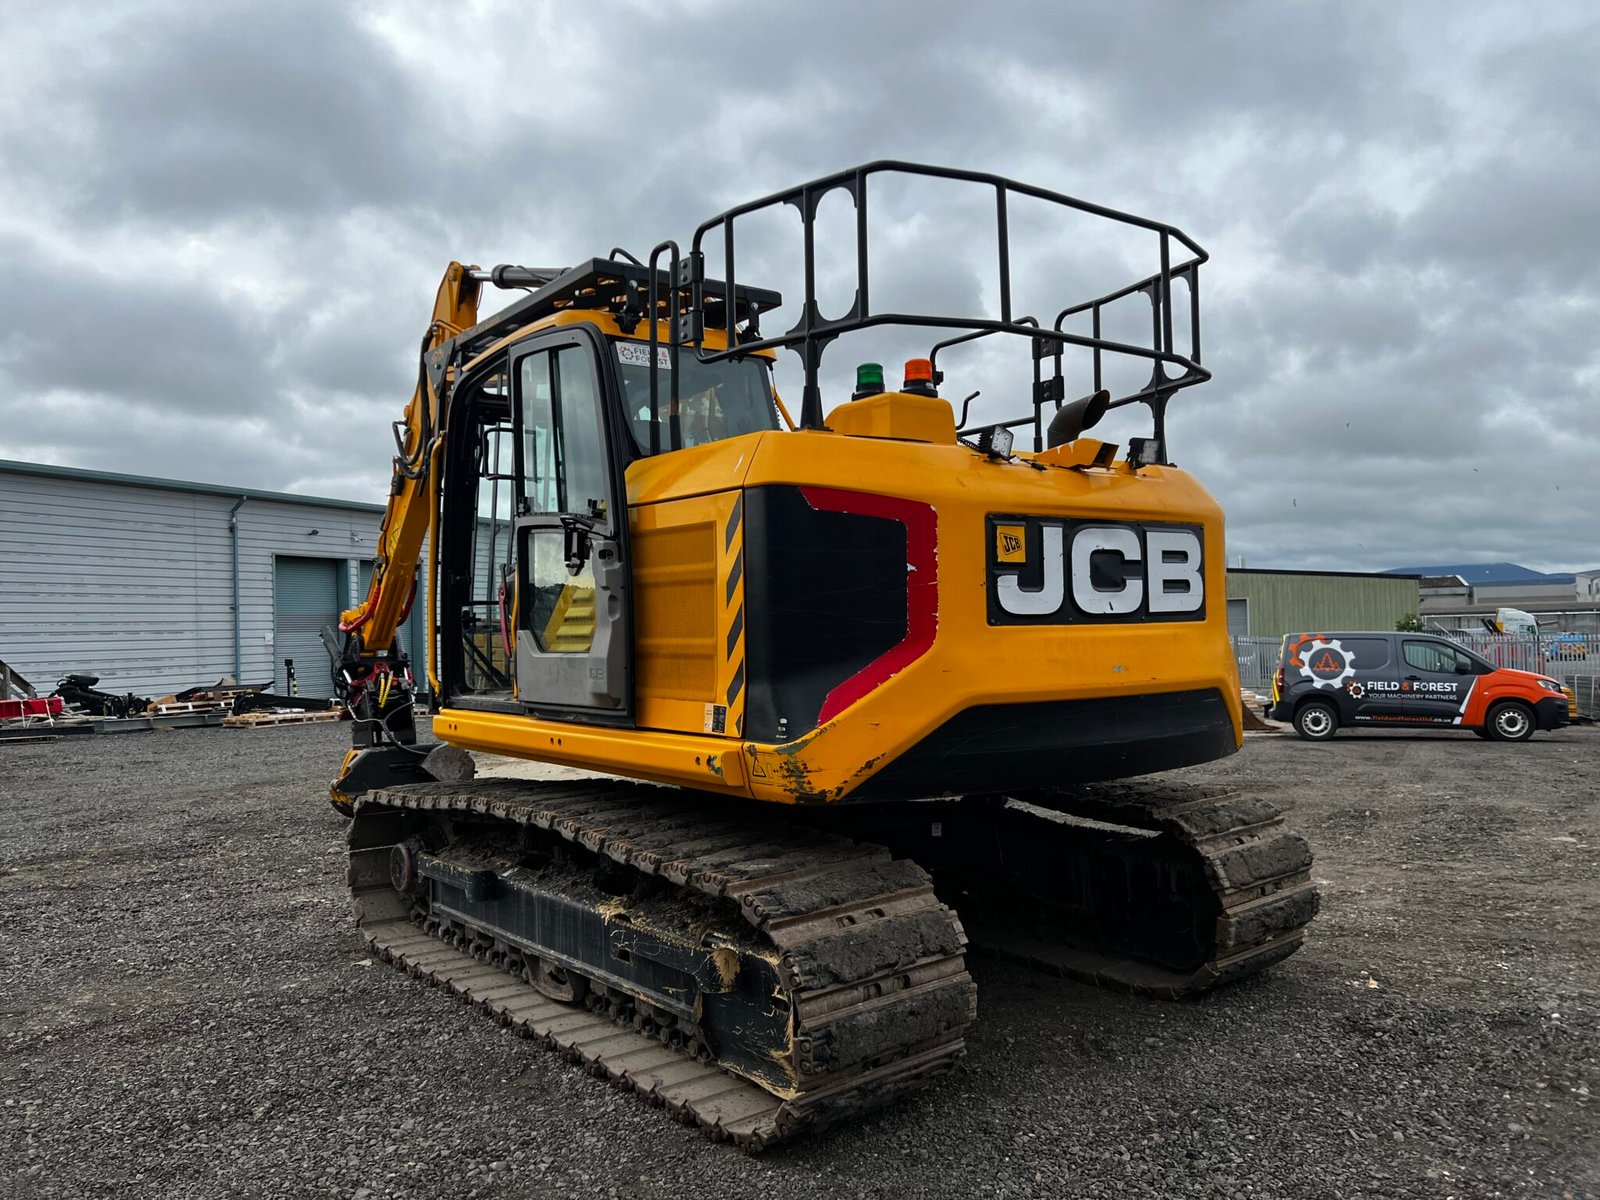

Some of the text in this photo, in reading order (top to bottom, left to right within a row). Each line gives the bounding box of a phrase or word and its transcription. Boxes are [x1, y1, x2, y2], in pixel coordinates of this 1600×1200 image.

[1003, 535, 1021, 553] JCB
[997, 526, 1204, 615] JCB
[1367, 681, 1458, 692] FIELD & FOREST
